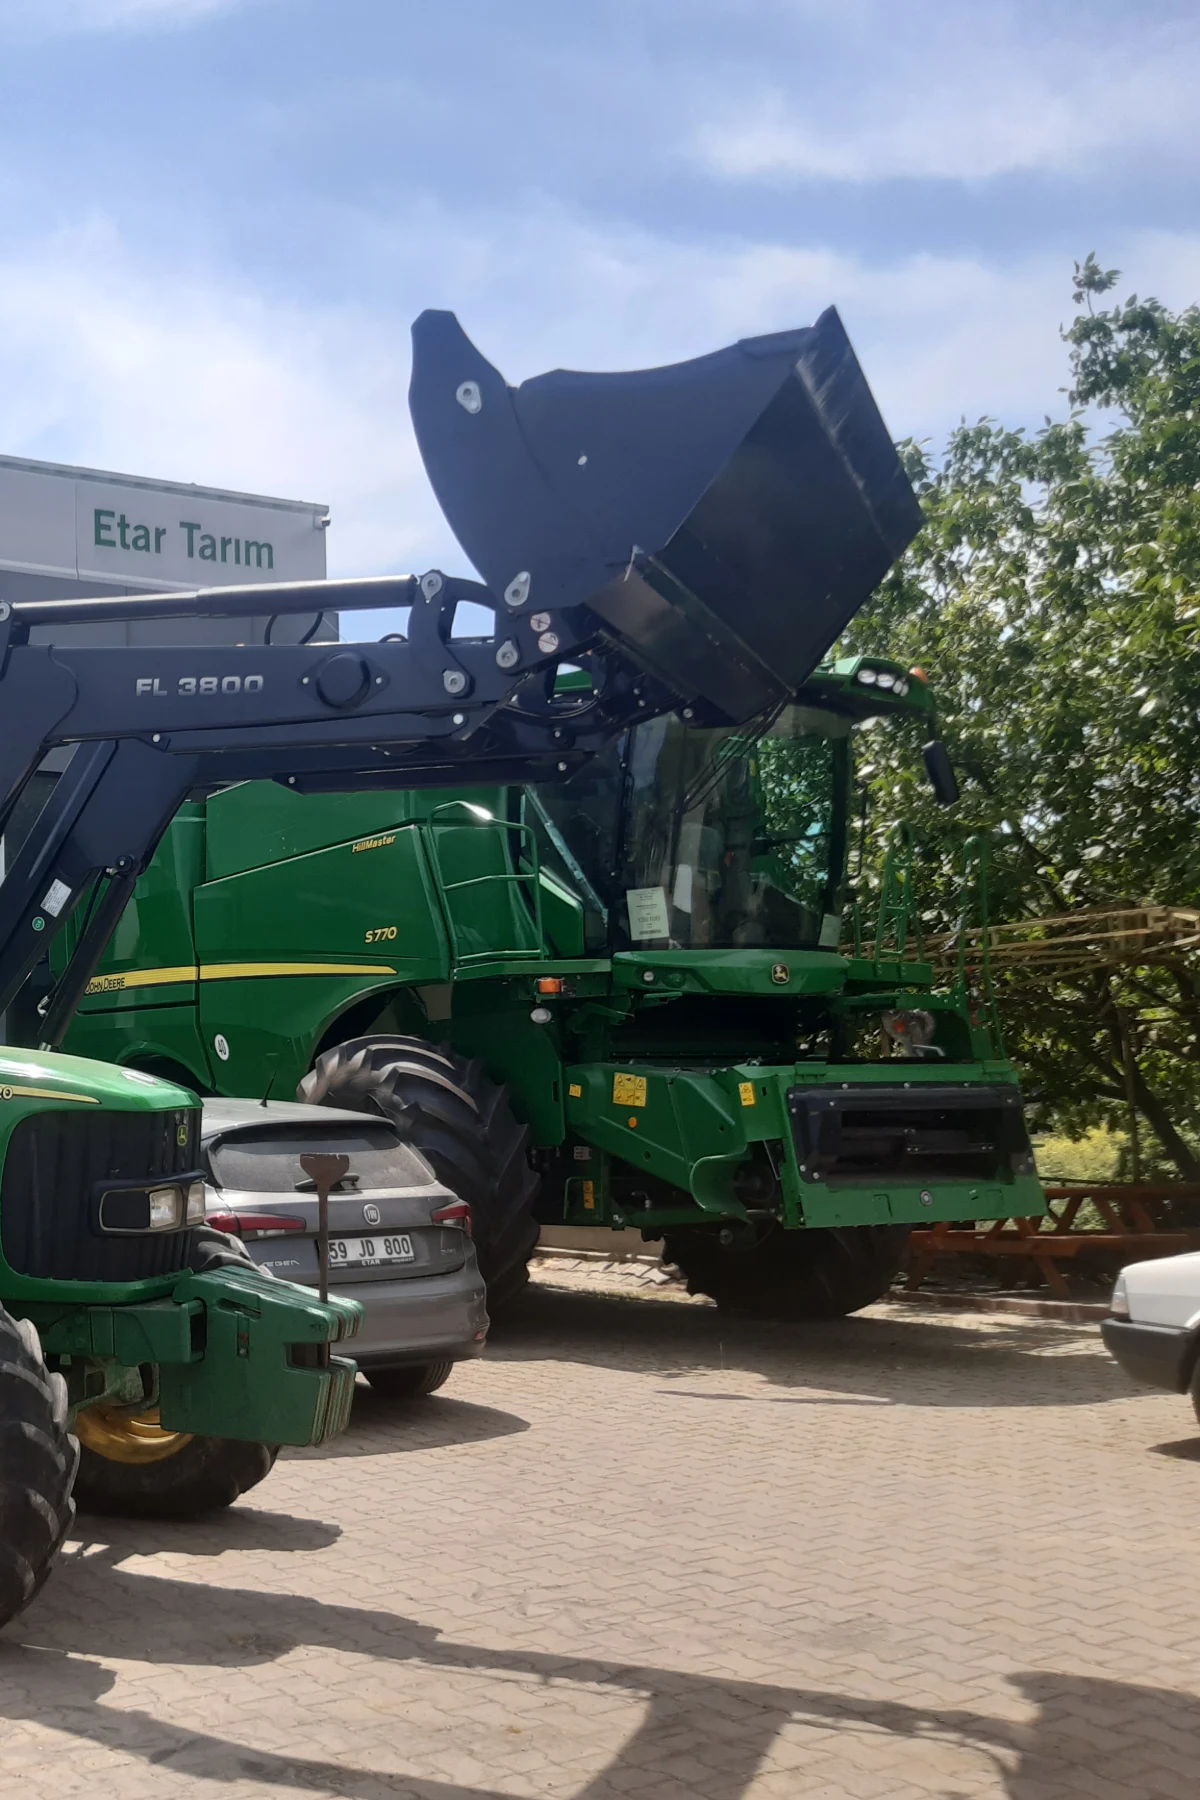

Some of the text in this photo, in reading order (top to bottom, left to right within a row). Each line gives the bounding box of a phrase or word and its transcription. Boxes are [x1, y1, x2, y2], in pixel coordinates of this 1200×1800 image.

[94, 508, 274, 569] Etar Tarım
[136, 675, 264, 697] FL 3800
[351, 834, 397, 853] HillMaster
[365, 926, 397, 943] S770
[85, 977, 126, 994] JOHN DEERE
[329, 1237, 411, 1260] 59 JD 800
